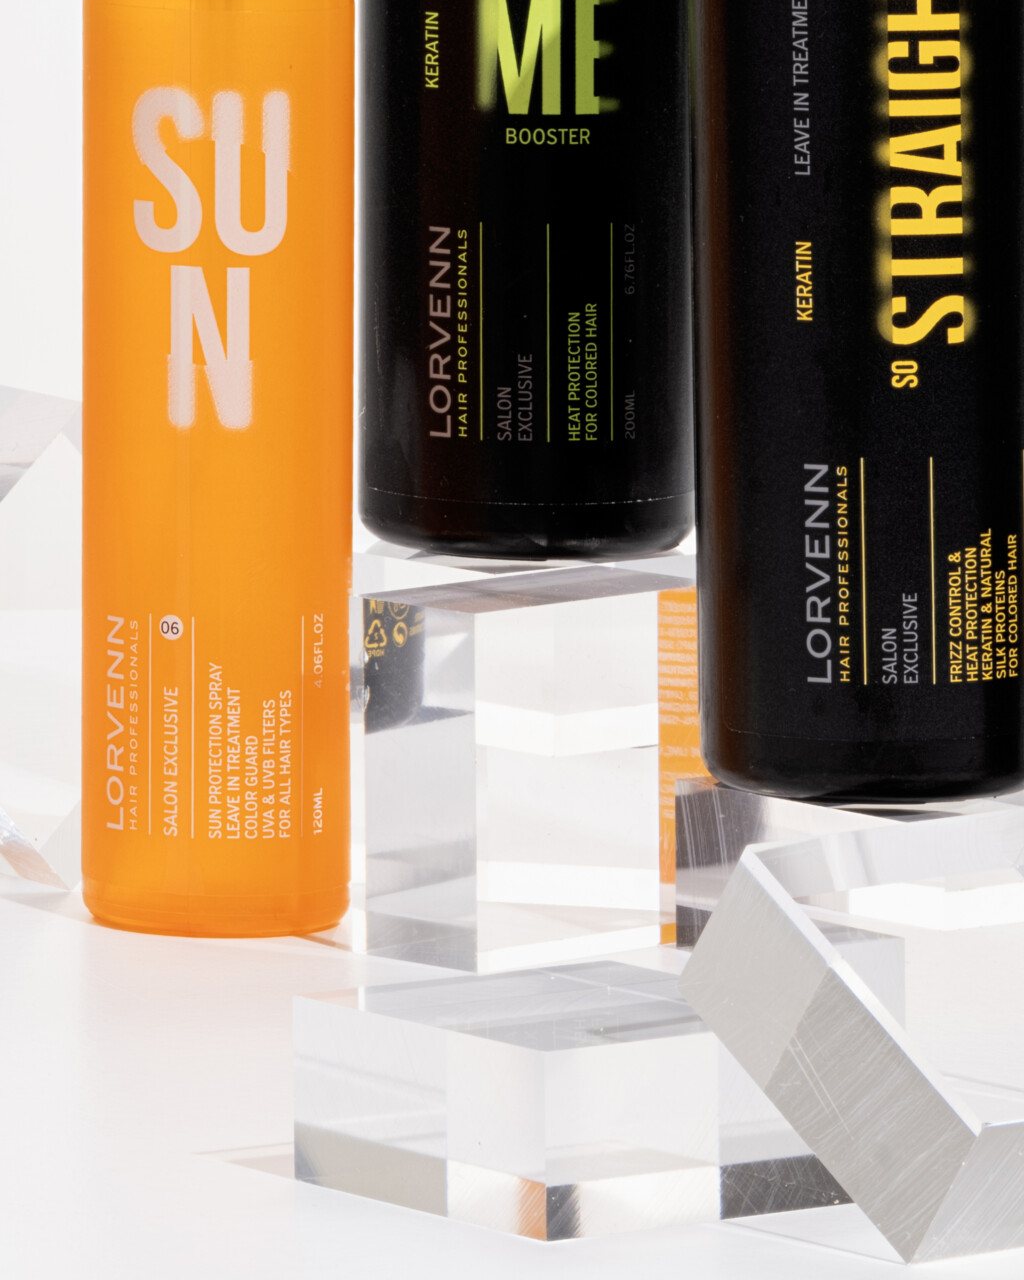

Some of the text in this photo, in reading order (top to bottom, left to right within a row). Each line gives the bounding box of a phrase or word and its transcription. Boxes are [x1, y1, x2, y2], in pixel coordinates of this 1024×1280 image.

[425, 11, 439, 88] KERATIN
[793, 92, 809, 112] IN
[132, 87, 290, 256] SU
[506, 128, 590, 145] BOOSTER
[794, 118, 810, 176] LEAVE
[429, 226, 450, 438] LORVENN
[458, 229, 467, 437] HAIR PROFESSIONALS
[796, 241, 812, 321] KERATIN
[168, 265, 253, 430] N
[498, 386, 511, 441] SALON
[518, 354, 532, 441] EXCLUSIVE
[568, 312, 580, 441] HEAT PROTECTION
[586, 303, 597, 441] FOR COLORED HAIR
[892, 360, 918, 388] SO
[625, 390, 635, 439] 200ML
[161, 621, 180, 635] 06
[804, 464, 832, 683] LORVENN
[837, 466, 850, 682] HAIR PROFESSIONALS
[903, 593, 918, 684] EXCLUSIVE
[948, 552, 962, 682] FRIZZ CONTROL &
[965, 547, 978, 682] HEAT PROTECTION
[981, 528, 993, 680] KERATIN & NATURAL
[995, 570, 1006, 679] SILK PROTEINS
[1008, 534, 1018, 677] FOR COLORED HAIR
[882, 628, 897, 684] SALON
[107, 615, 124, 830] LORVENN
[130, 620, 138, 830] HAIR PROFESSIONALS
[164, 687, 178, 836] SALON EXCLUSIVE
[209, 662, 223, 839] SUN PROTECTION SPRAY
[227, 687, 241, 839] LEAVE IN TREATMENT
[245, 735, 258, 839] COLOR GUARD
[262, 699, 275, 839] UVA & UVB FILTERS
[280, 689, 292, 838] FOR ALL HAIR TYPES
[313, 787, 322, 836] 120ML
